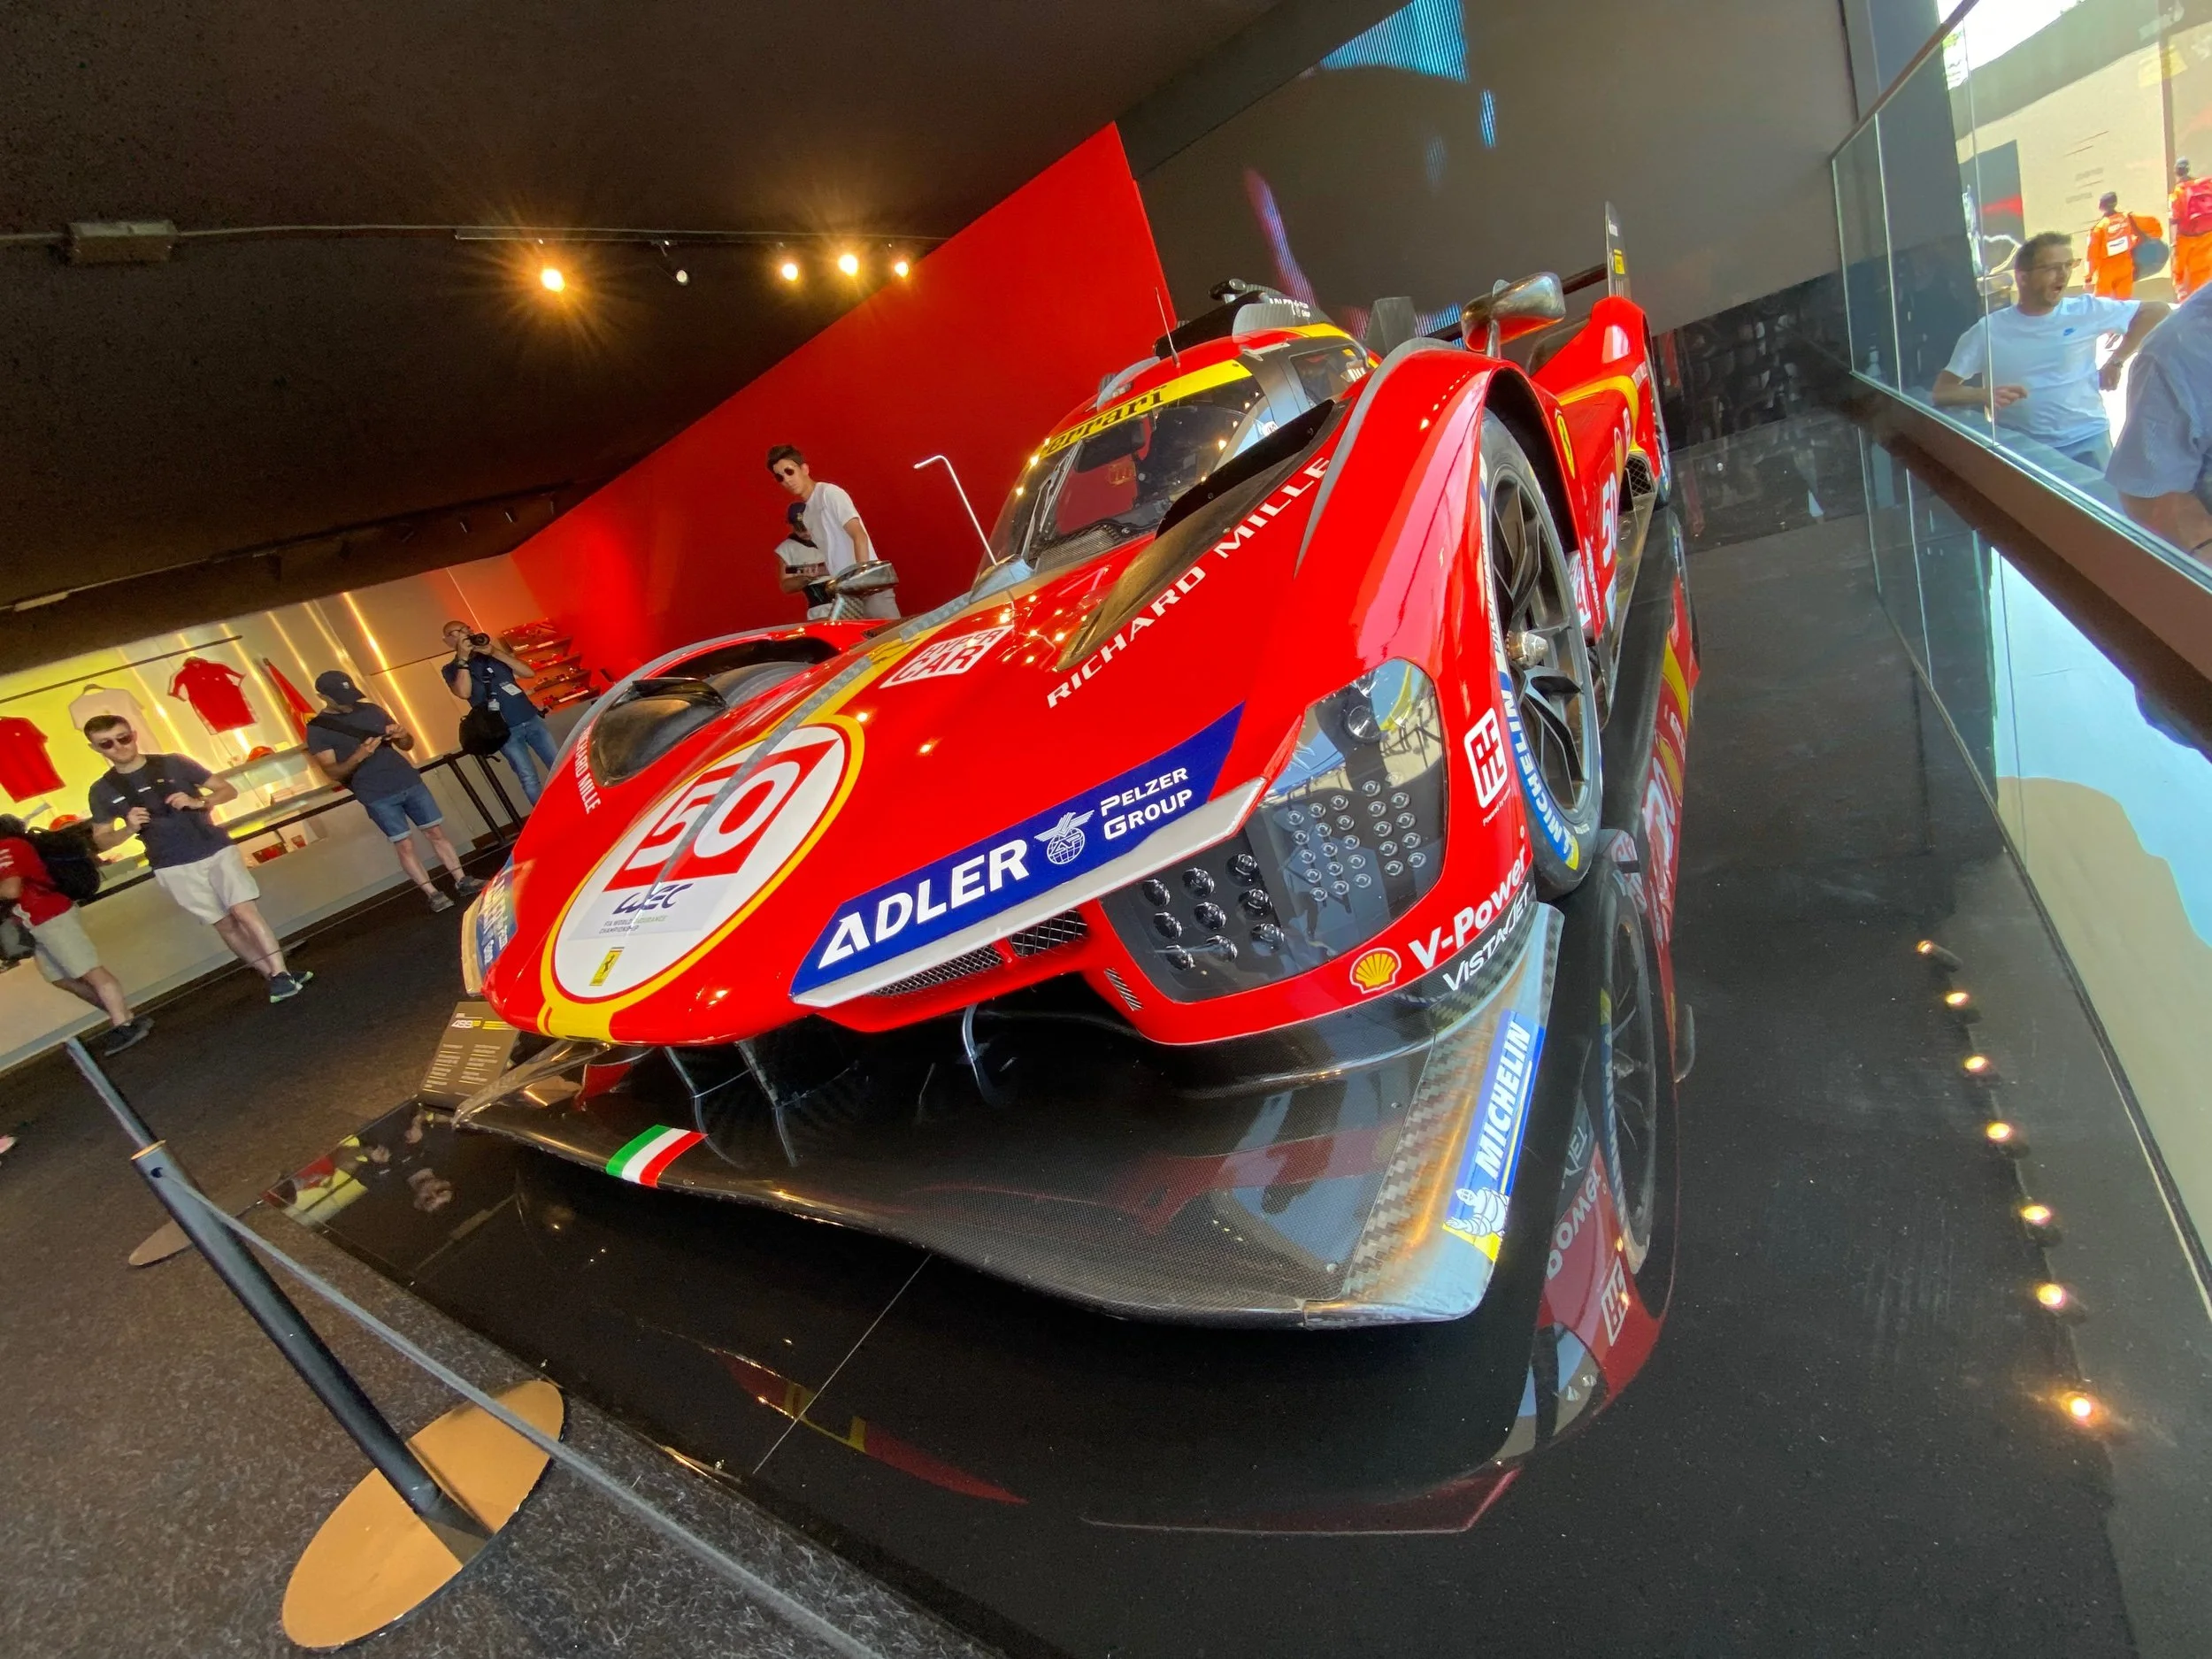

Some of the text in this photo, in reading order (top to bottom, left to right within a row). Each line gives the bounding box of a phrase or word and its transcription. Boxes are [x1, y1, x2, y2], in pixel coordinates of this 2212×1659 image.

[1046, 384, 1168, 455] errari
[1047, 457, 1330, 709] RICHARD MILLE
[890, 644, 985, 683] CAR
[577, 772, 602, 815] MILLE
[624, 760, 802, 872] 50
[1101, 766, 1188, 817] PELZER
[1103, 788, 1193, 841] GROUP
[1501, 688, 1563, 843] MICHELIN
[612, 883, 694, 915] WEC
[818, 839, 1030, 970] ADLER
[1409, 846, 1527, 971] V-Power
[1442, 882, 1529, 992] VISTAJET
[1475, 1021, 1532, 1180] MICHELIN
